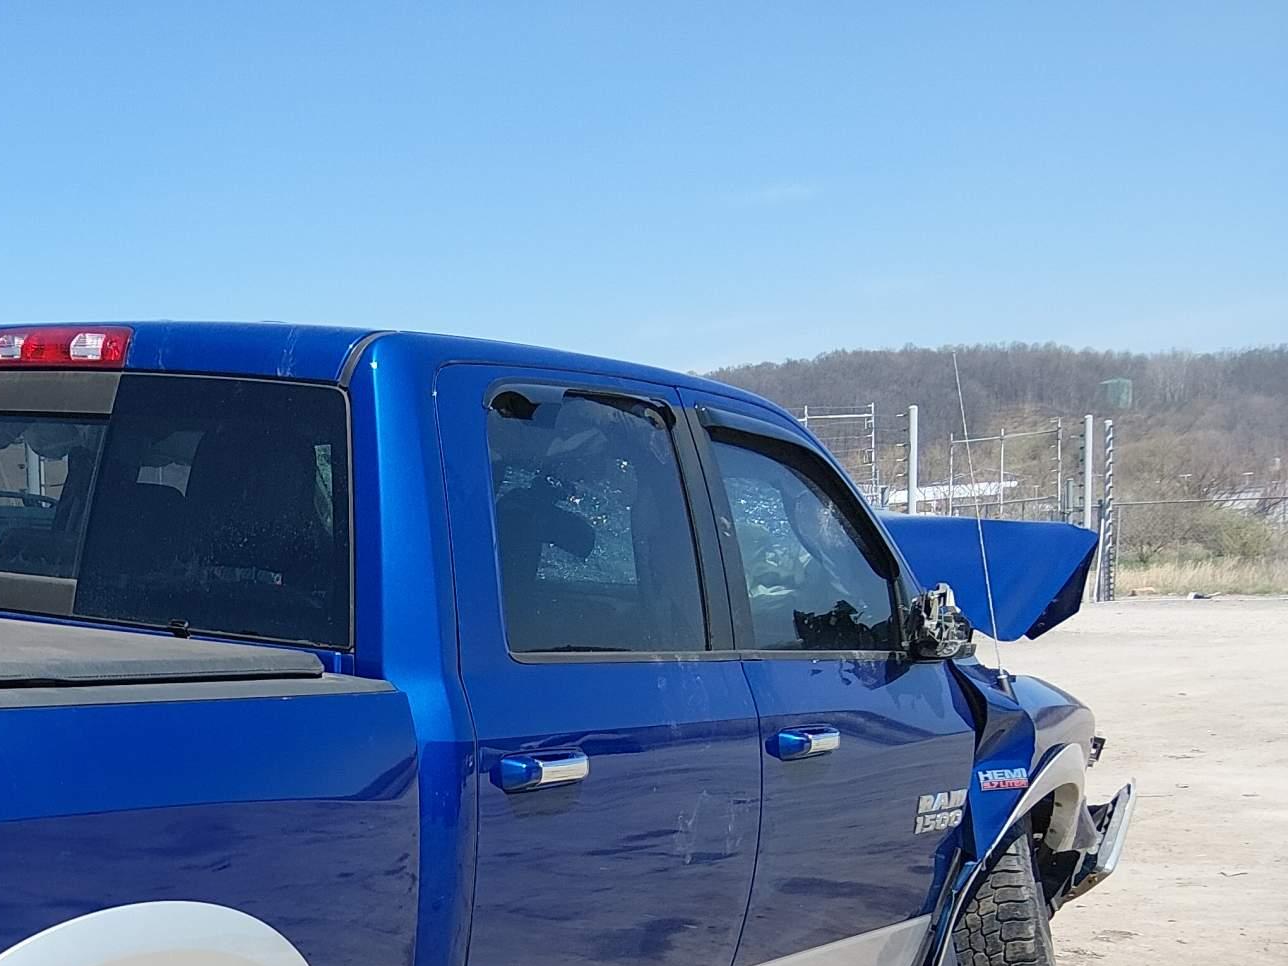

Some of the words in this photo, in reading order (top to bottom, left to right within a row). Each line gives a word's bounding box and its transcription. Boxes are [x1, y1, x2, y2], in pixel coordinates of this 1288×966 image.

[978, 768, 1027, 780] HEMI
[918, 789, 968, 814] RAM
[914, 809, 963, 834] 1500
